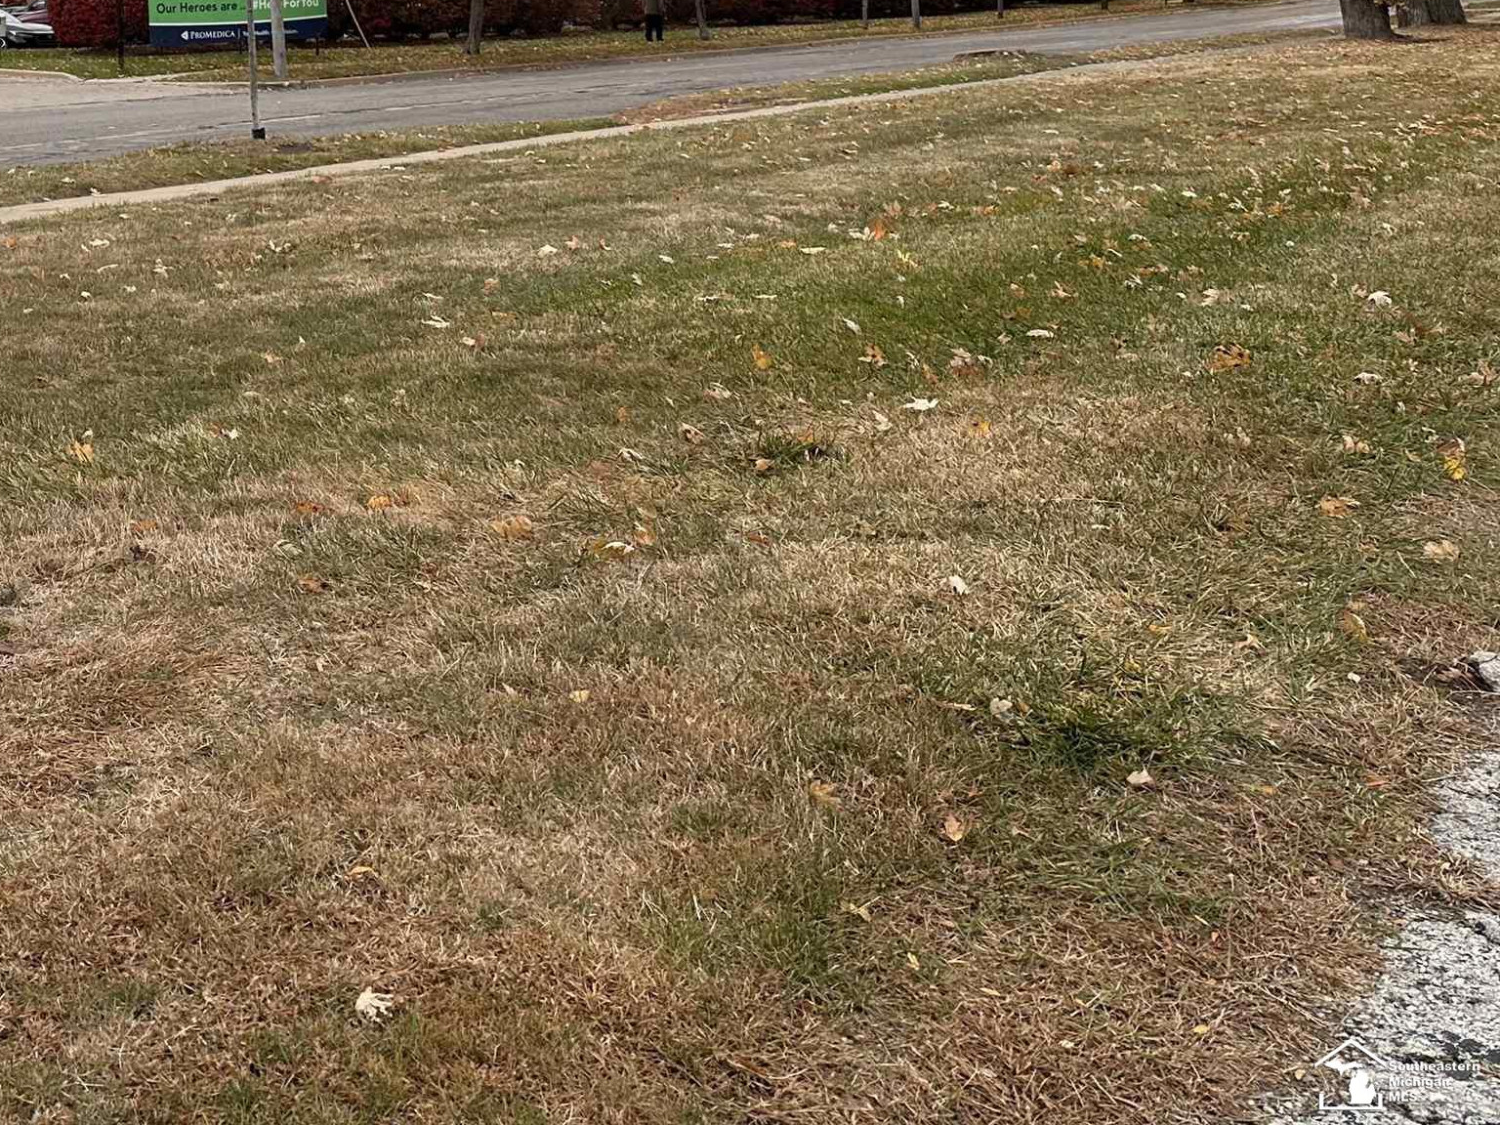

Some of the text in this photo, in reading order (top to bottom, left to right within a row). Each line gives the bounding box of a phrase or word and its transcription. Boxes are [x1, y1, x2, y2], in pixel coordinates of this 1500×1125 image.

[156, 3, 176, 14] Our
[179, 2, 217, 13] Heroes
[220, 2, 238, 11] are
[190, 30, 235, 39] PROMEDICA
